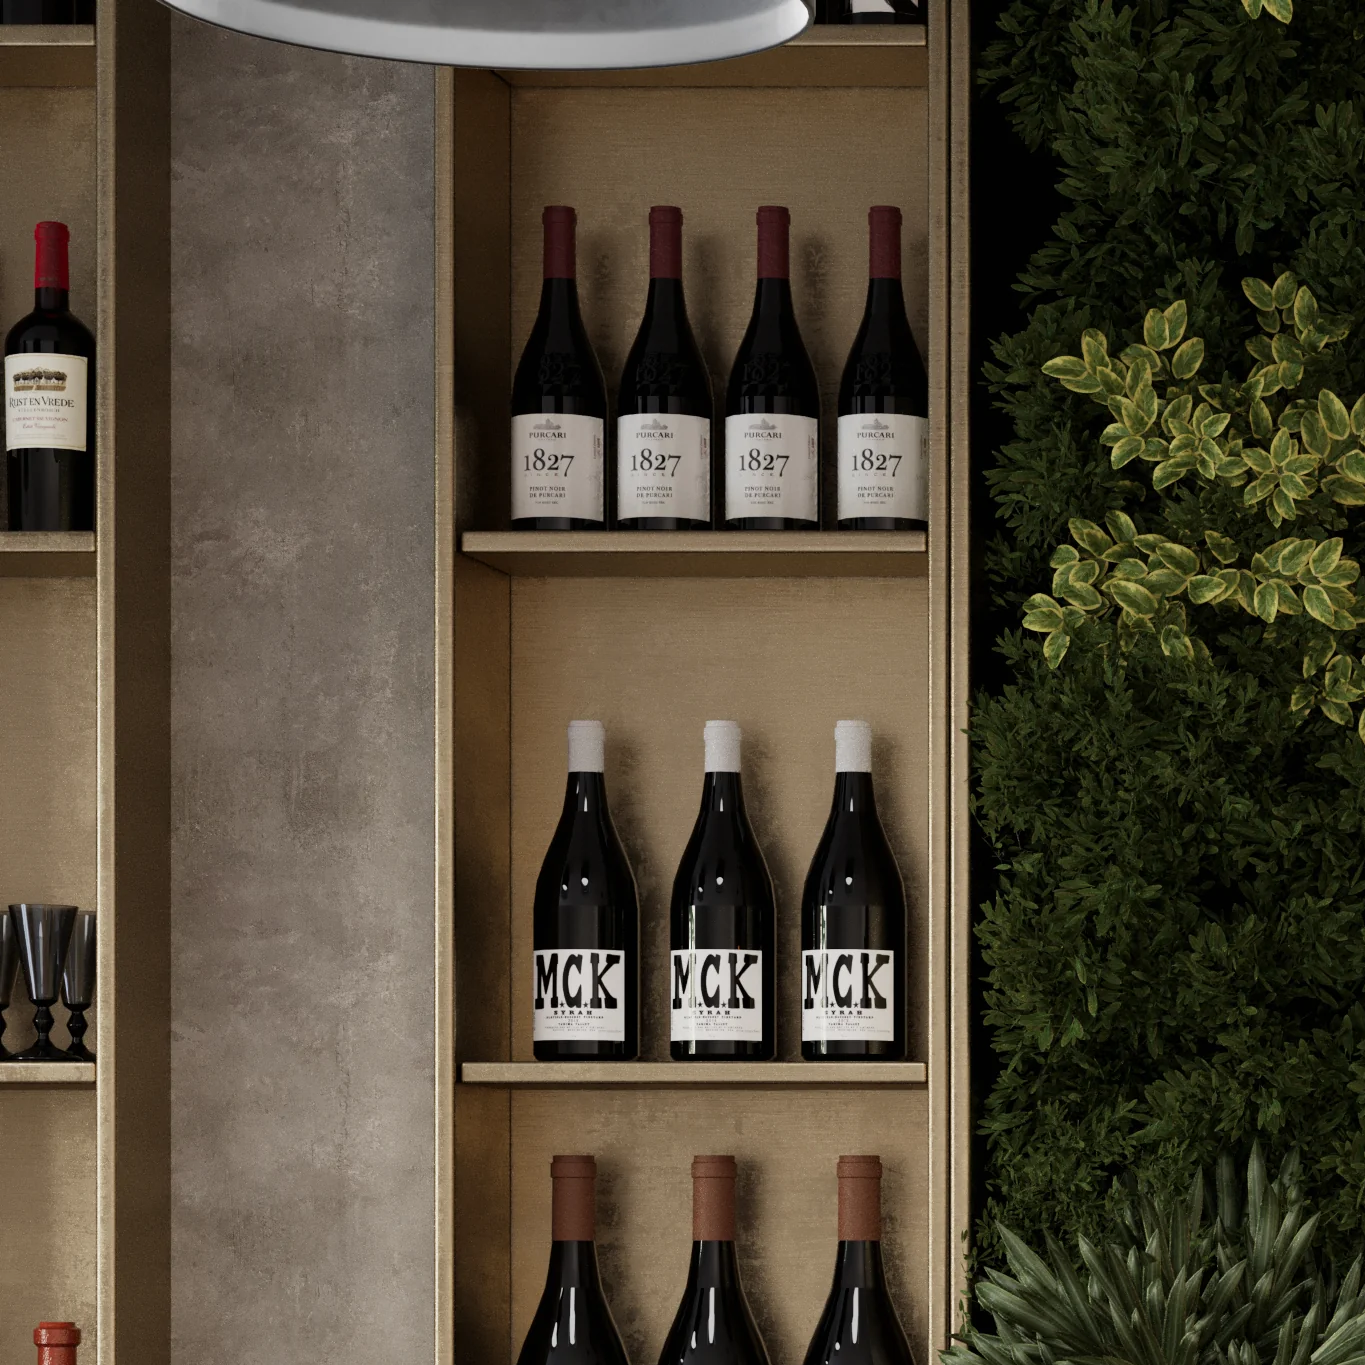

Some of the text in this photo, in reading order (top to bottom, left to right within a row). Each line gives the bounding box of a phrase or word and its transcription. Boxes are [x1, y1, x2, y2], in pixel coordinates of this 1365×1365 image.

[9, 396, 74, 408] RUST EN VREDE
[524, 448, 575, 477] 1827
[631, 448, 682, 477] 1827
[739, 448, 790, 477] 1827
[852, 448, 903, 477] 1827
[535, 952, 621, 1010] MCK
[804, 952, 890, 1010] MCK
